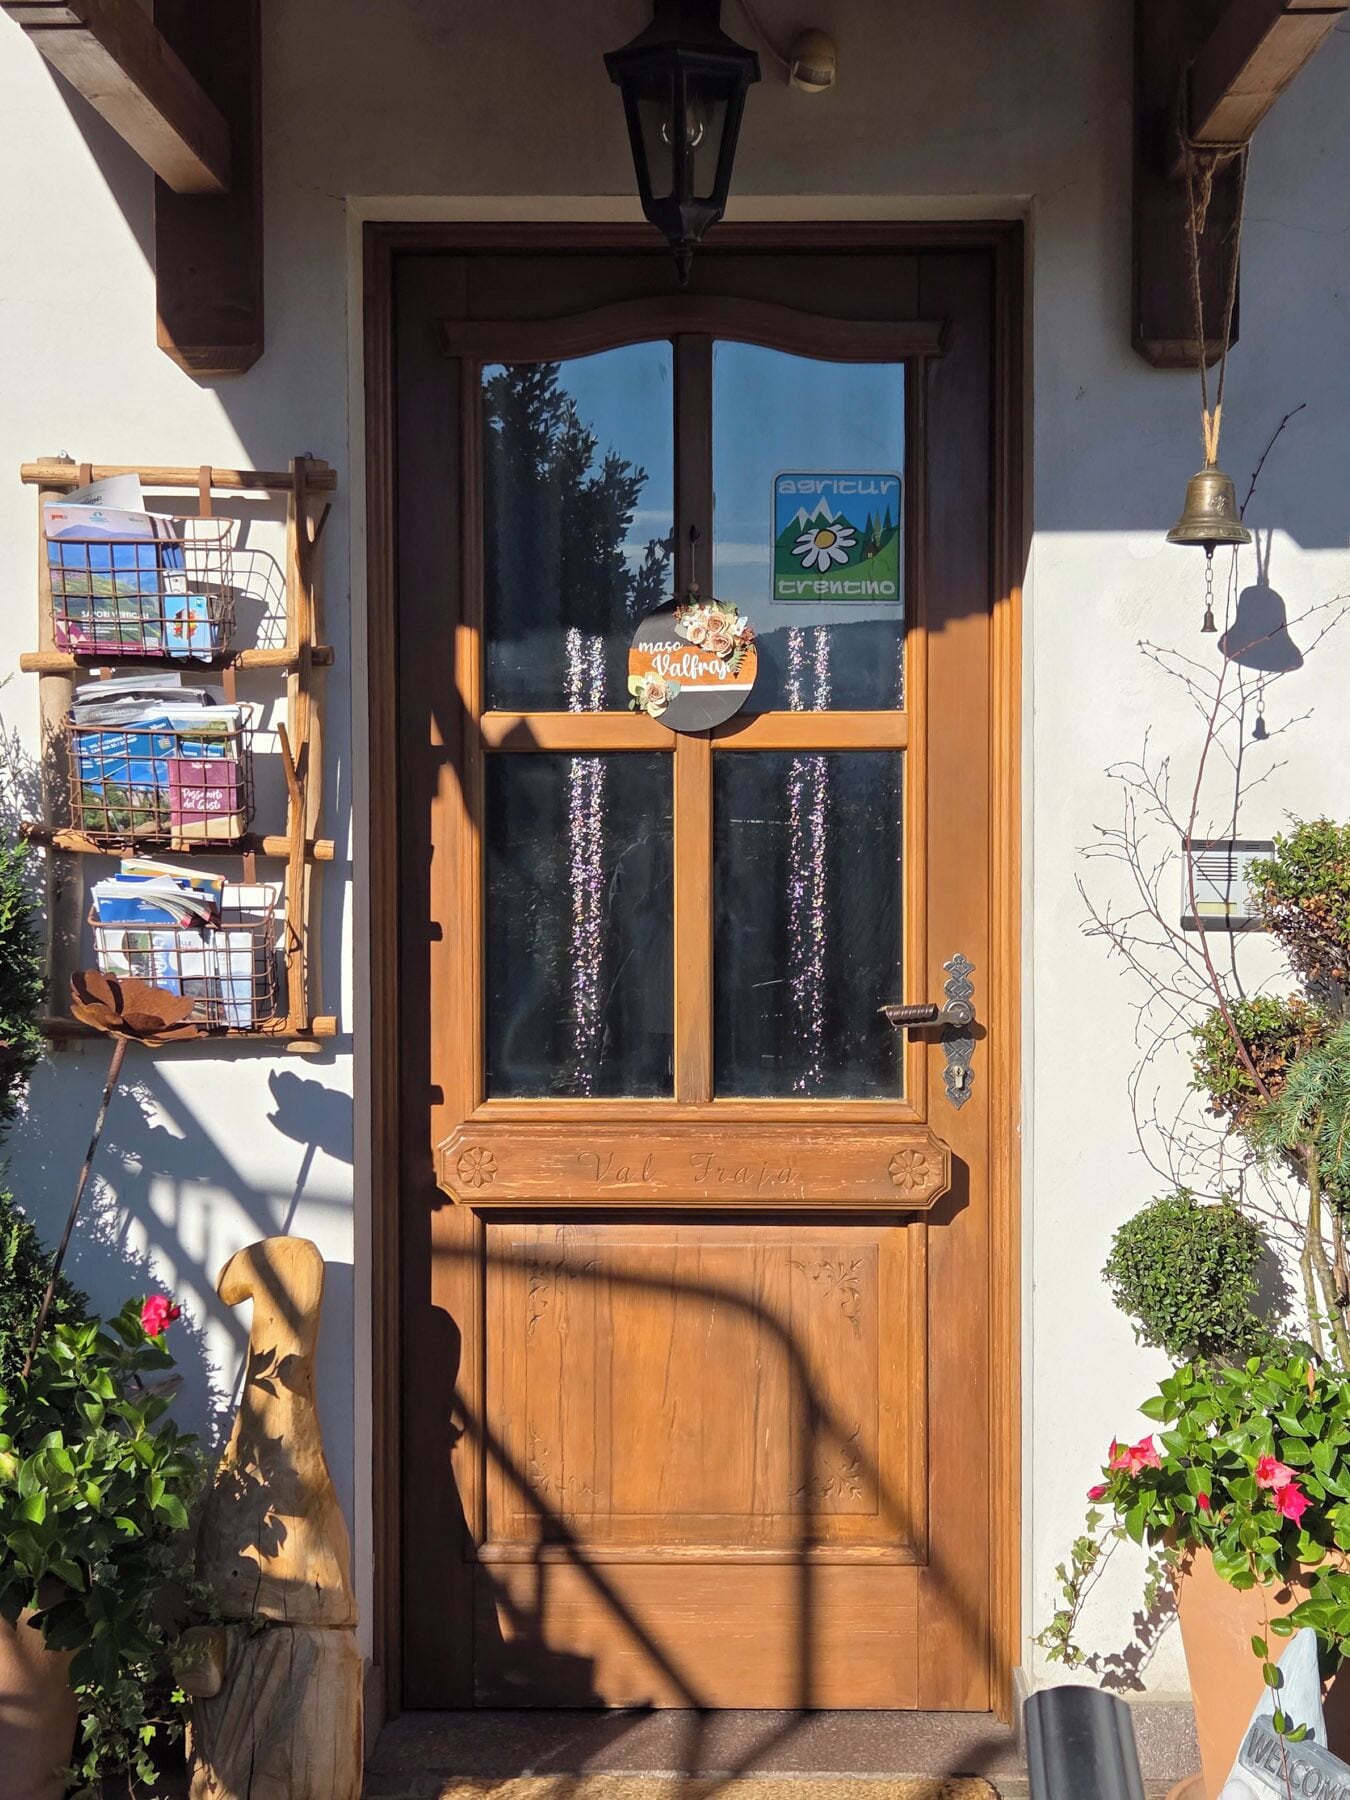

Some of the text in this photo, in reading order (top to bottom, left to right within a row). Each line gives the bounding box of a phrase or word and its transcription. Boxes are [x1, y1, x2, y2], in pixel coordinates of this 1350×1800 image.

[778, 479, 897, 495] agritur
[778, 580, 896, 595] trentino
[638, 641, 683, 654] maso
[651, 653, 731, 680] Valfraj
[181, 787, 223, 800] Passaorto
[577, 1152, 656, 1184] Val
